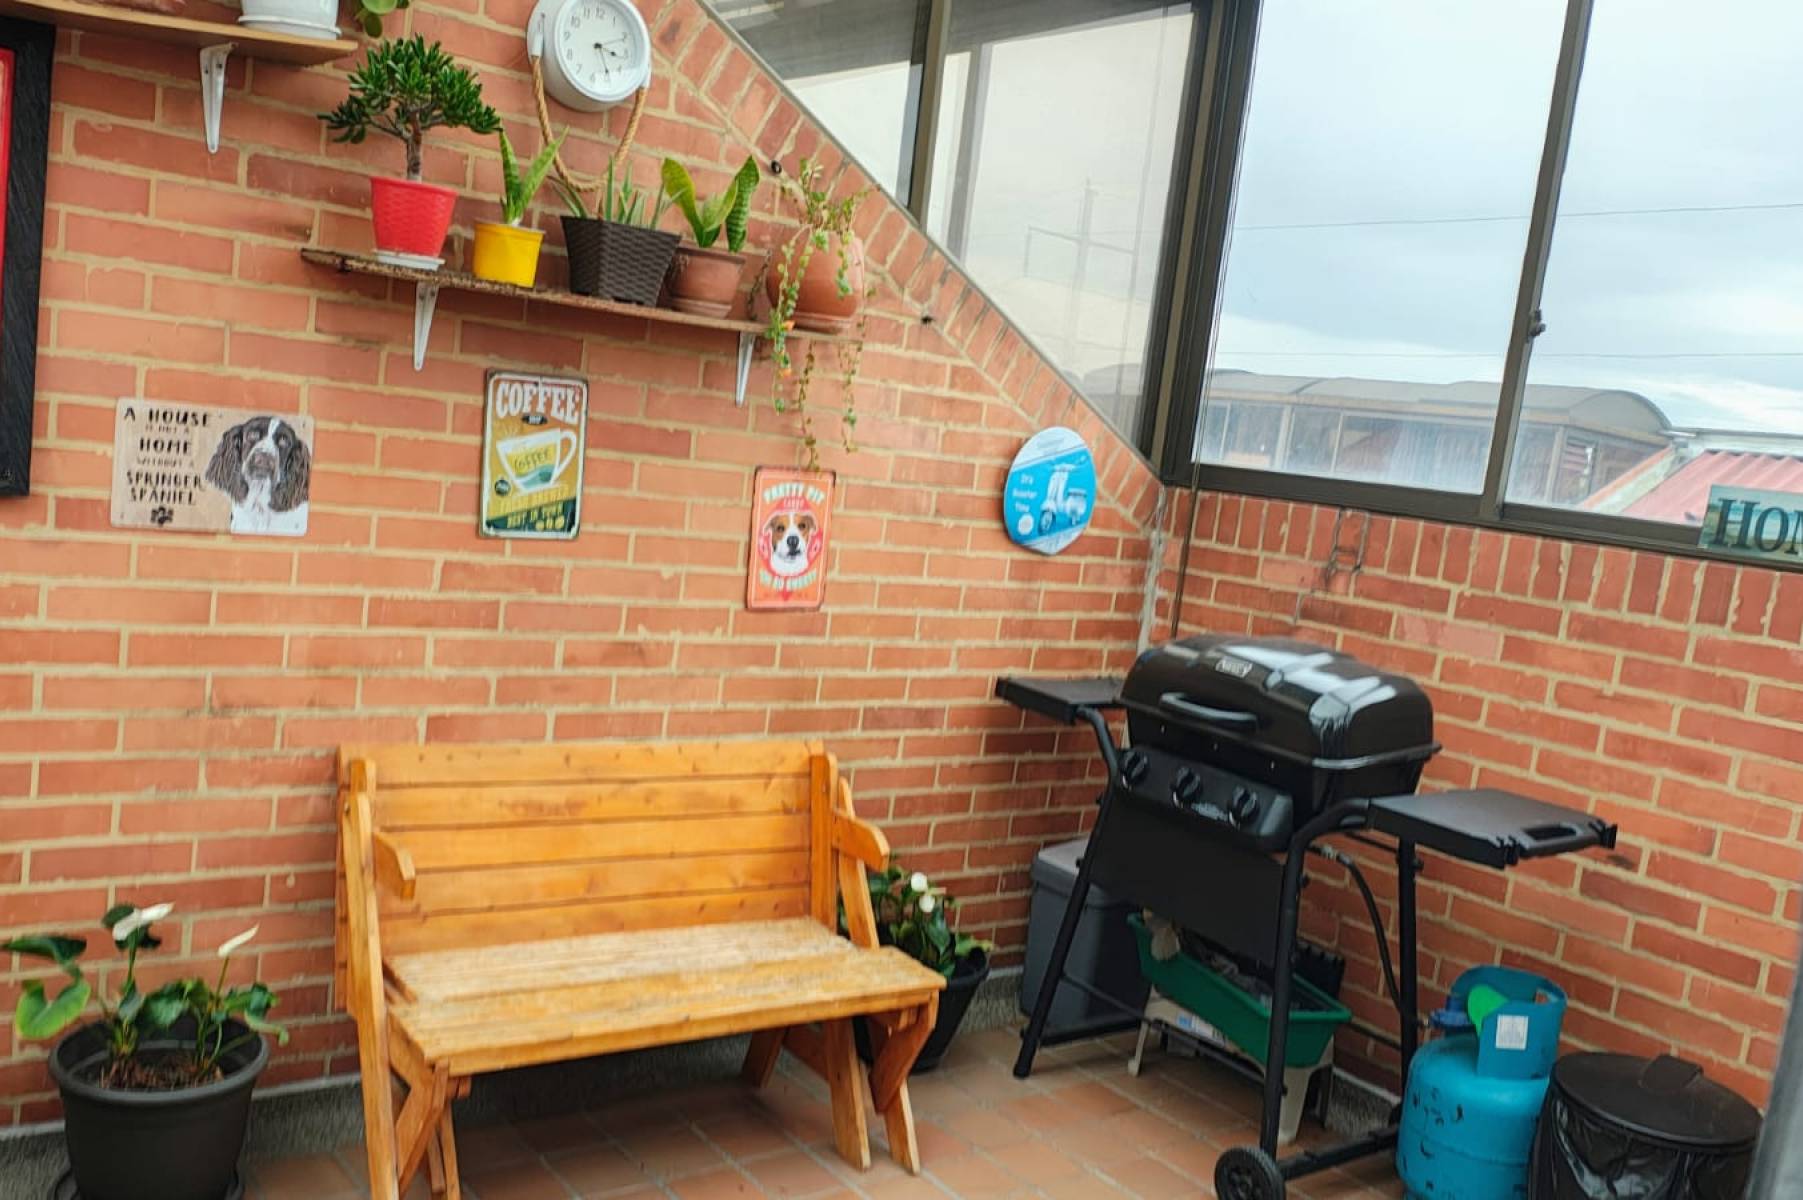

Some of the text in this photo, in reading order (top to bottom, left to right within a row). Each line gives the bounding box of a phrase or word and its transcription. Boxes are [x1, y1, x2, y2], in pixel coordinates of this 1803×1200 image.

[495, 381, 579, 425] COFFEE
[124, 406, 209, 428] A HOUSE
[140, 437, 192, 455] HOME
[127, 470, 204, 491] SPRINGER
[130, 487, 197, 506] SPANIEL
